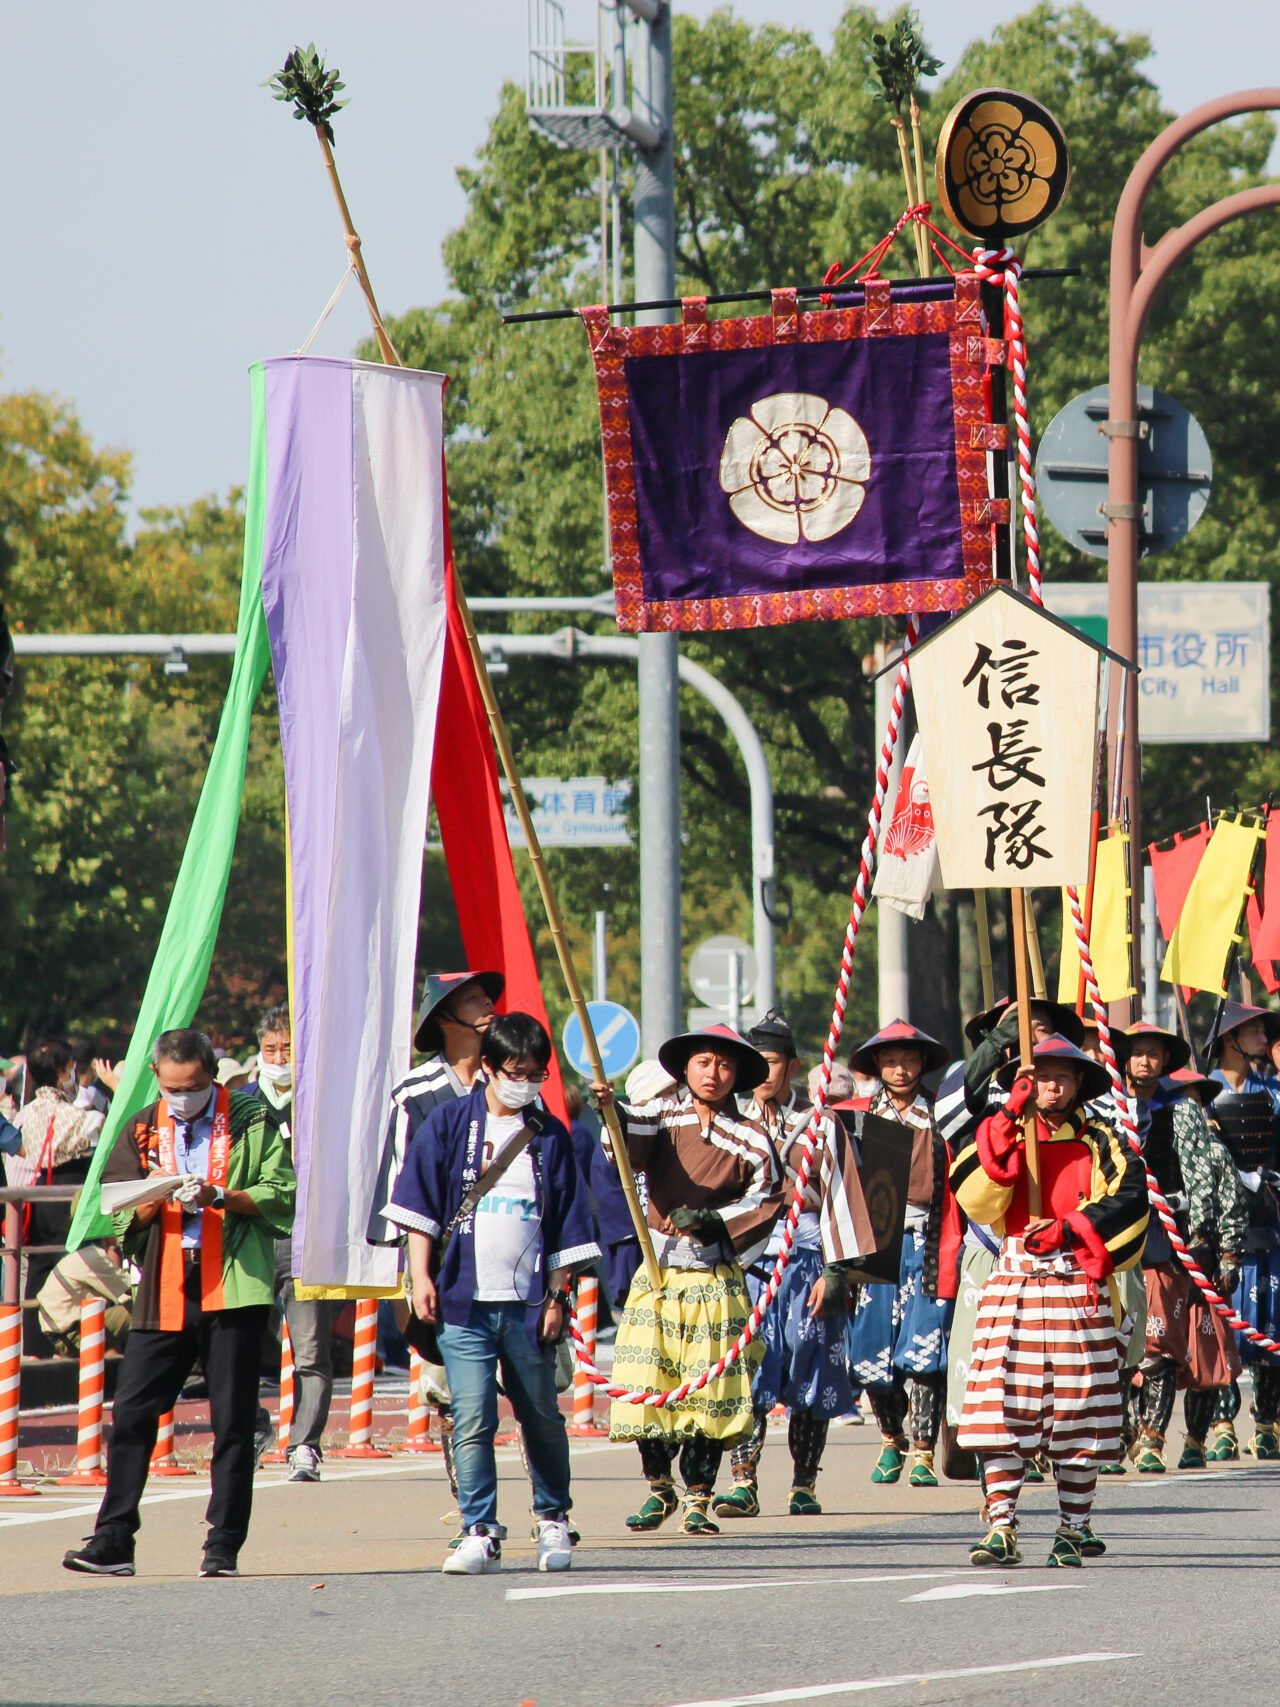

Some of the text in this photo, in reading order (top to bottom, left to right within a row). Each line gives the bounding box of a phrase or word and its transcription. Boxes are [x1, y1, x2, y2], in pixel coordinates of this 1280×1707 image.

[1138, 632, 1250, 669] 市役所
[1141, 675, 1240, 699] City Hall
[963, 639, 1053, 872] 信長隊
[542, 789, 630, 815] 体育館
[212, 1112, 226, 1180] 名古屋まつり
[466, 1120, 479, 1165] 名古屋まつり
